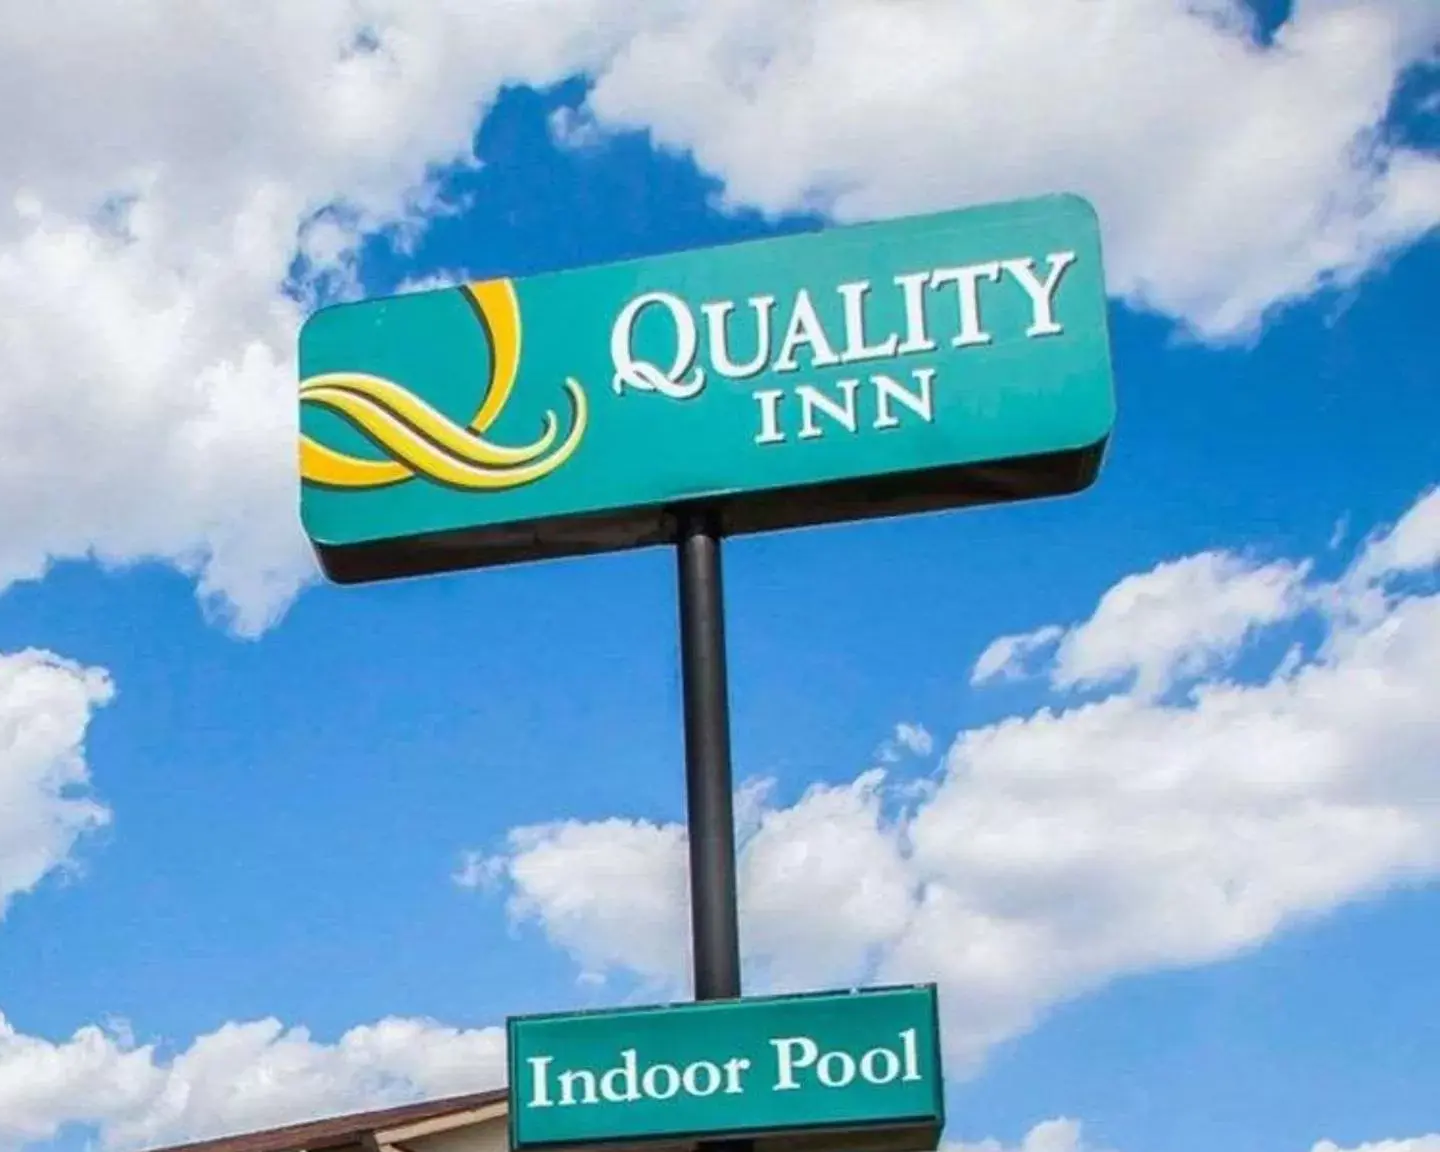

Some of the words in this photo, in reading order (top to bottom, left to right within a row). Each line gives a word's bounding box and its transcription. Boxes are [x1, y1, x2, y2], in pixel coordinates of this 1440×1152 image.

[610, 250, 1076, 399] QUALITY
[753, 367, 936, 444] INN
[527, 1048, 751, 1107] Indoor
[769, 1028, 922, 1091] Pool
